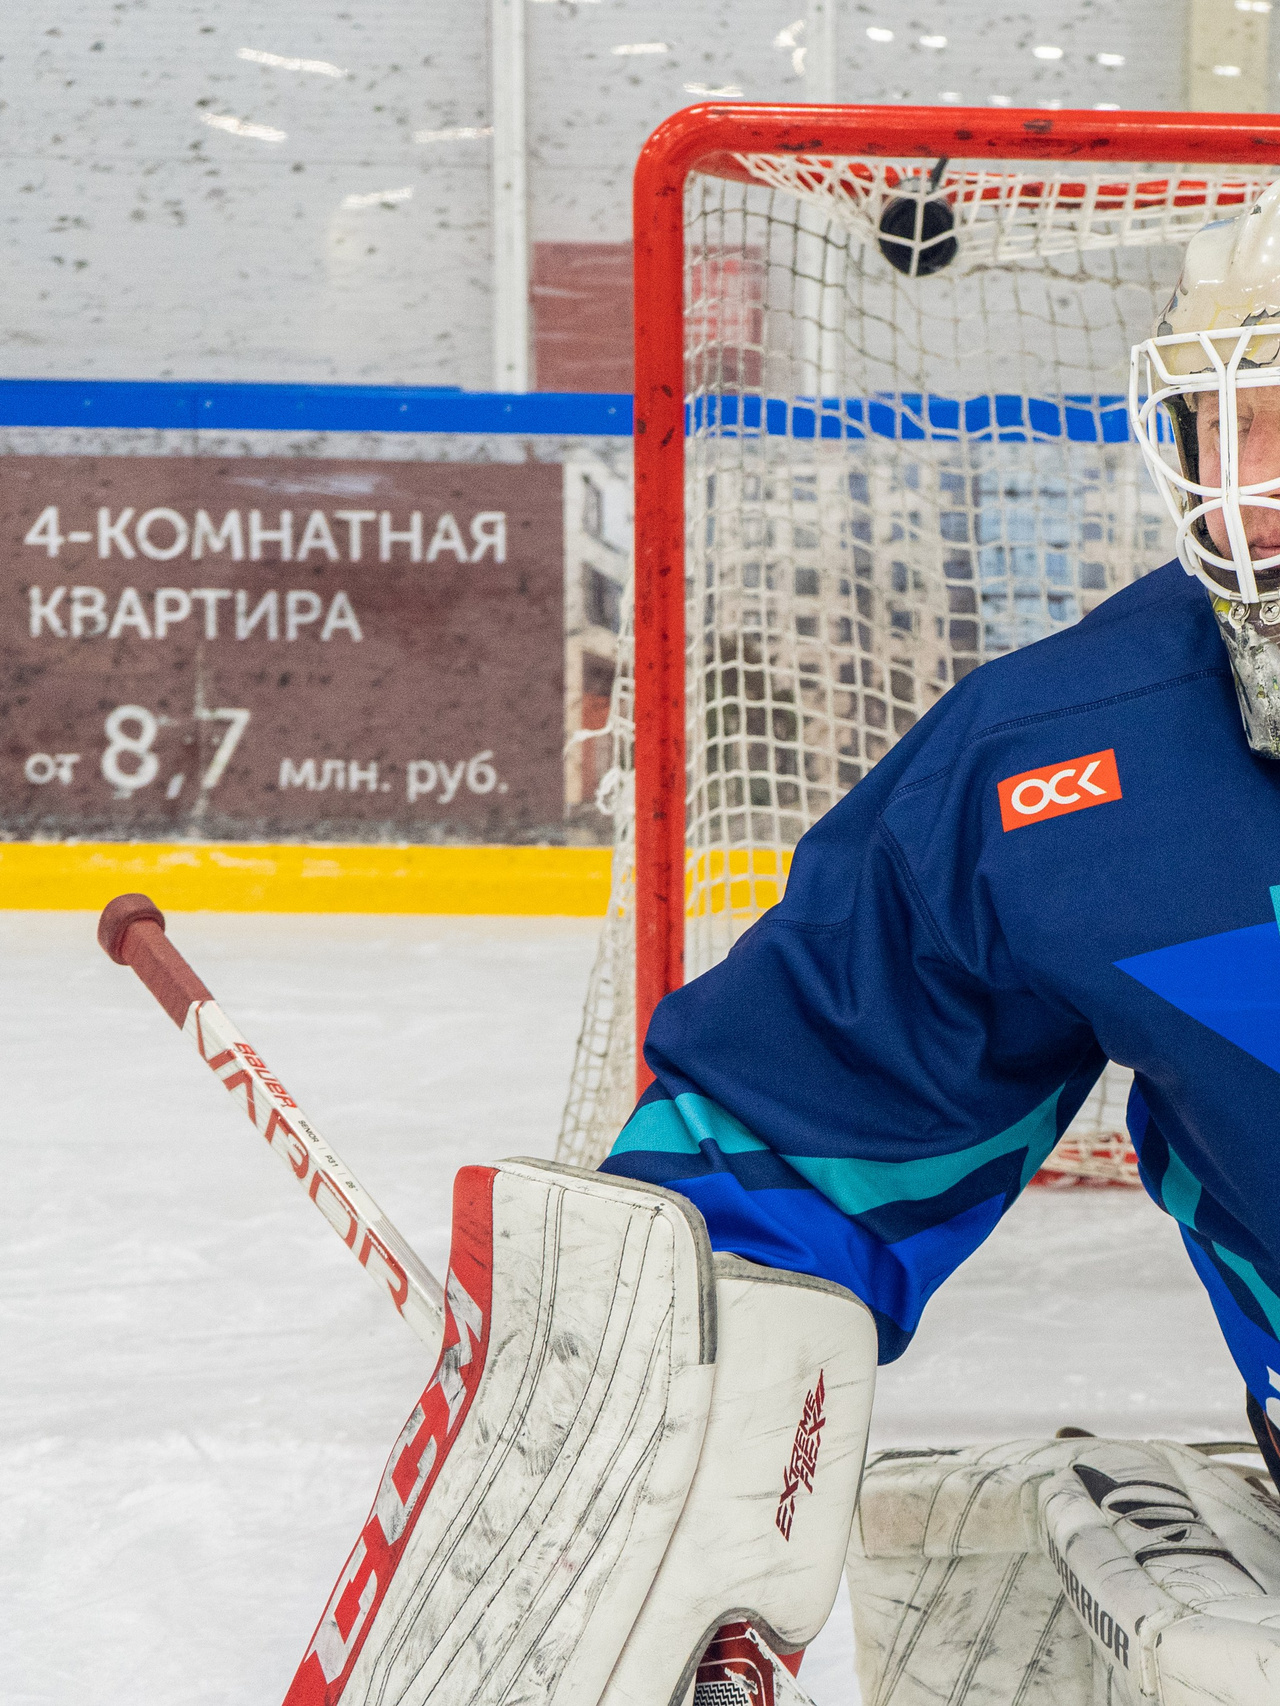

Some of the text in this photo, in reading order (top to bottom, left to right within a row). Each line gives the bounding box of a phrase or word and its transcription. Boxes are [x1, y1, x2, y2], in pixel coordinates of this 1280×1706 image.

[26, 506, 508, 564] 4-КОМНАТНАЯ
[29, 586, 363, 642] КВАРТИРА
[25, 704, 508, 804] от 8,7 млн. руб.
[234, 1042, 298, 1108] BAUER
[298, 1120, 320, 1143] SENIOR
[304, 1267, 482, 1684] CCM
[775, 1389, 817, 1542] EXTREME
[1047, 1532, 1130, 1671] WARRIOR
